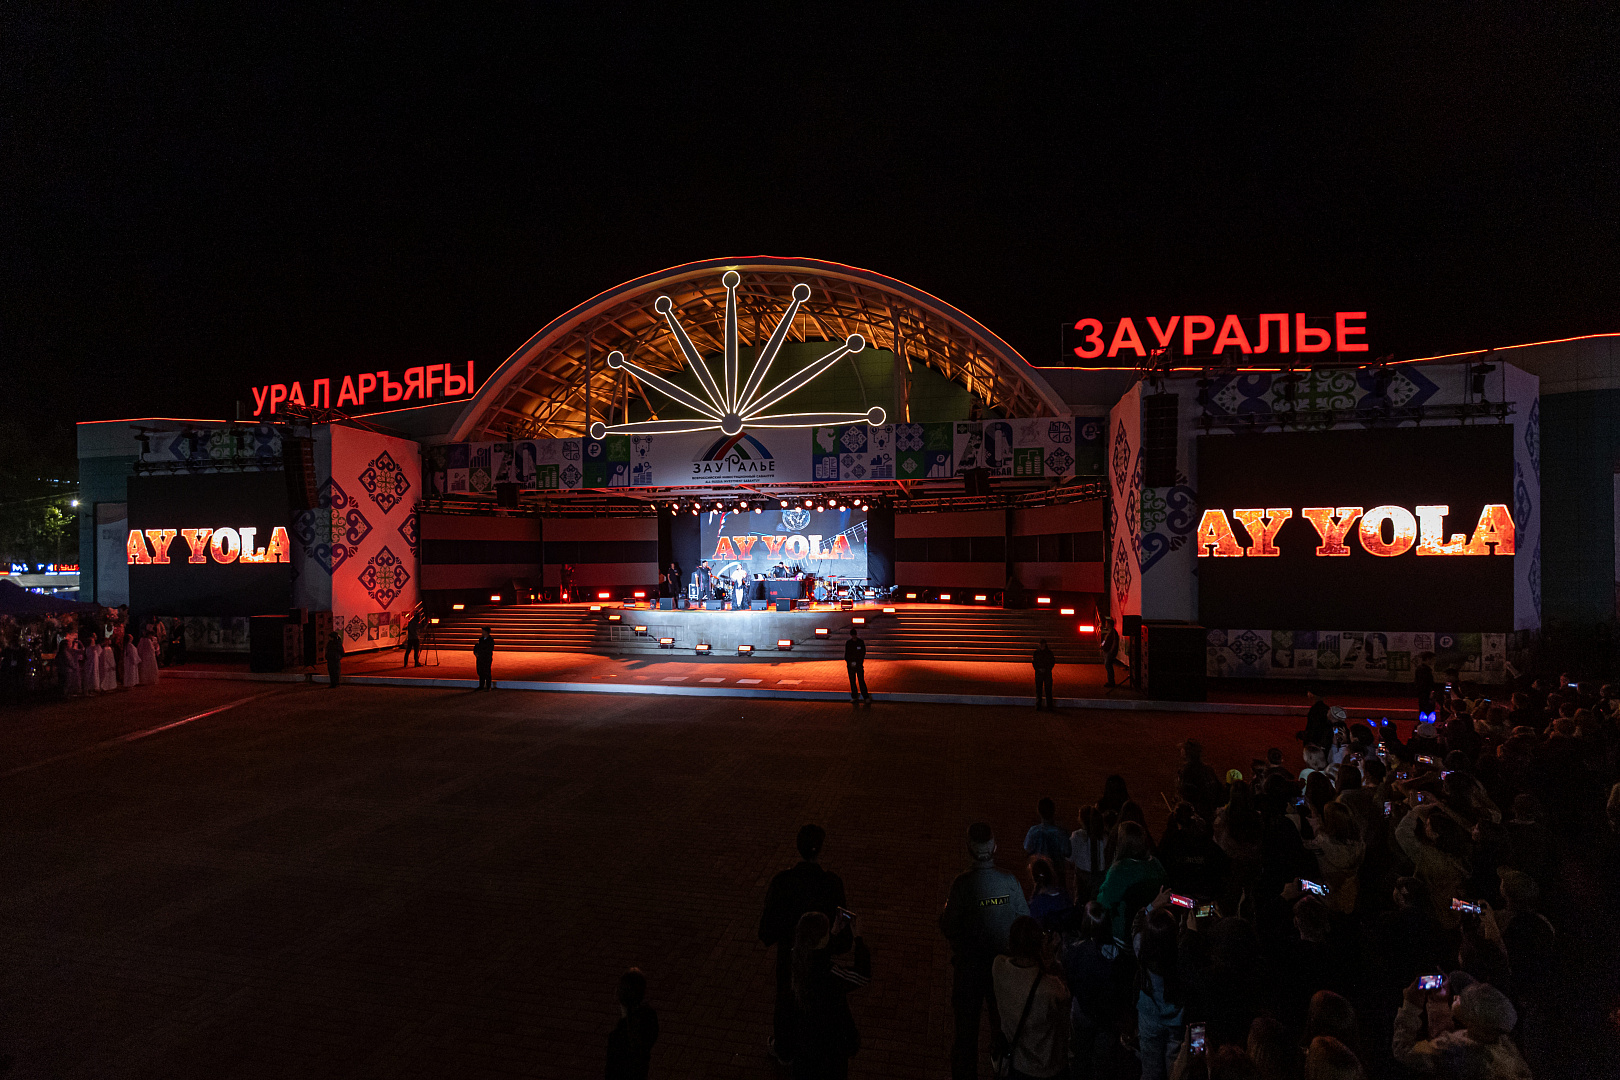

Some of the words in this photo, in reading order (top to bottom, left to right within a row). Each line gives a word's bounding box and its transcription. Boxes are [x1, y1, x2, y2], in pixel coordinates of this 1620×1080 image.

[1073, 311, 1369, 359] ЗАУРАЛЬЕ
[252, 378, 331, 417] УРАЛ
[337, 360, 474, 408] АРЪЯҒЫ
[692, 454, 775, 474] ЗАУРАЛЬЕ
[127, 529, 177, 565] AY
[181, 526, 290, 565] YOLA
[711, 535, 758, 561] AY
[761, 534, 855, 561] YOLA
[1197, 508, 1293, 557] AY
[1301, 503, 1516, 557] YOLA
